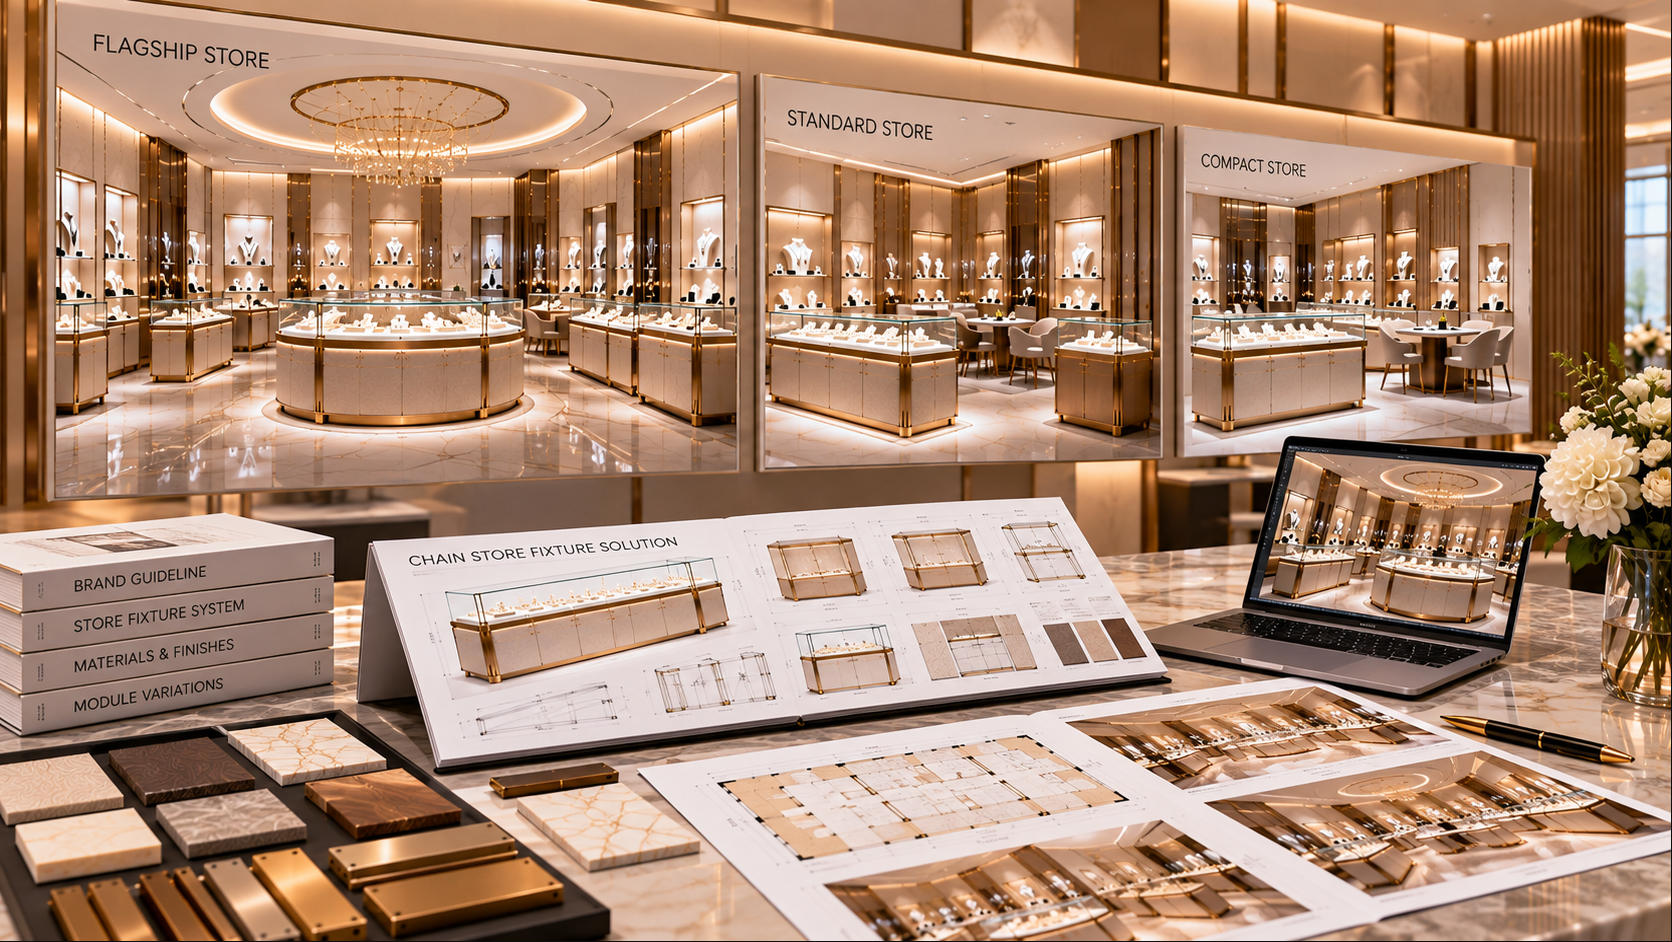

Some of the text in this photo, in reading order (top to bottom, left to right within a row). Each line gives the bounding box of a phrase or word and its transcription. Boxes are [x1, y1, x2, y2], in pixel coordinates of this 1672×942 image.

[93, 33, 270, 70] FLAGSHIP STORE
[787, 108, 934, 141] STANDARD STORE
[1200, 152, 1307, 178] COMPACT STORE
[408, 536, 678, 567] CHAIN STORE FIXTURE SOLUTION
[74, 565, 207, 593] BRAND GUIDELINE
[73, 598, 245, 633] STORE FIXTURE SYSTEM
[74, 638, 235, 673] MATERIALS & FINISHES
[74, 690, 137, 713] MODULE
[142, 677, 224, 702] VARIATIONS
